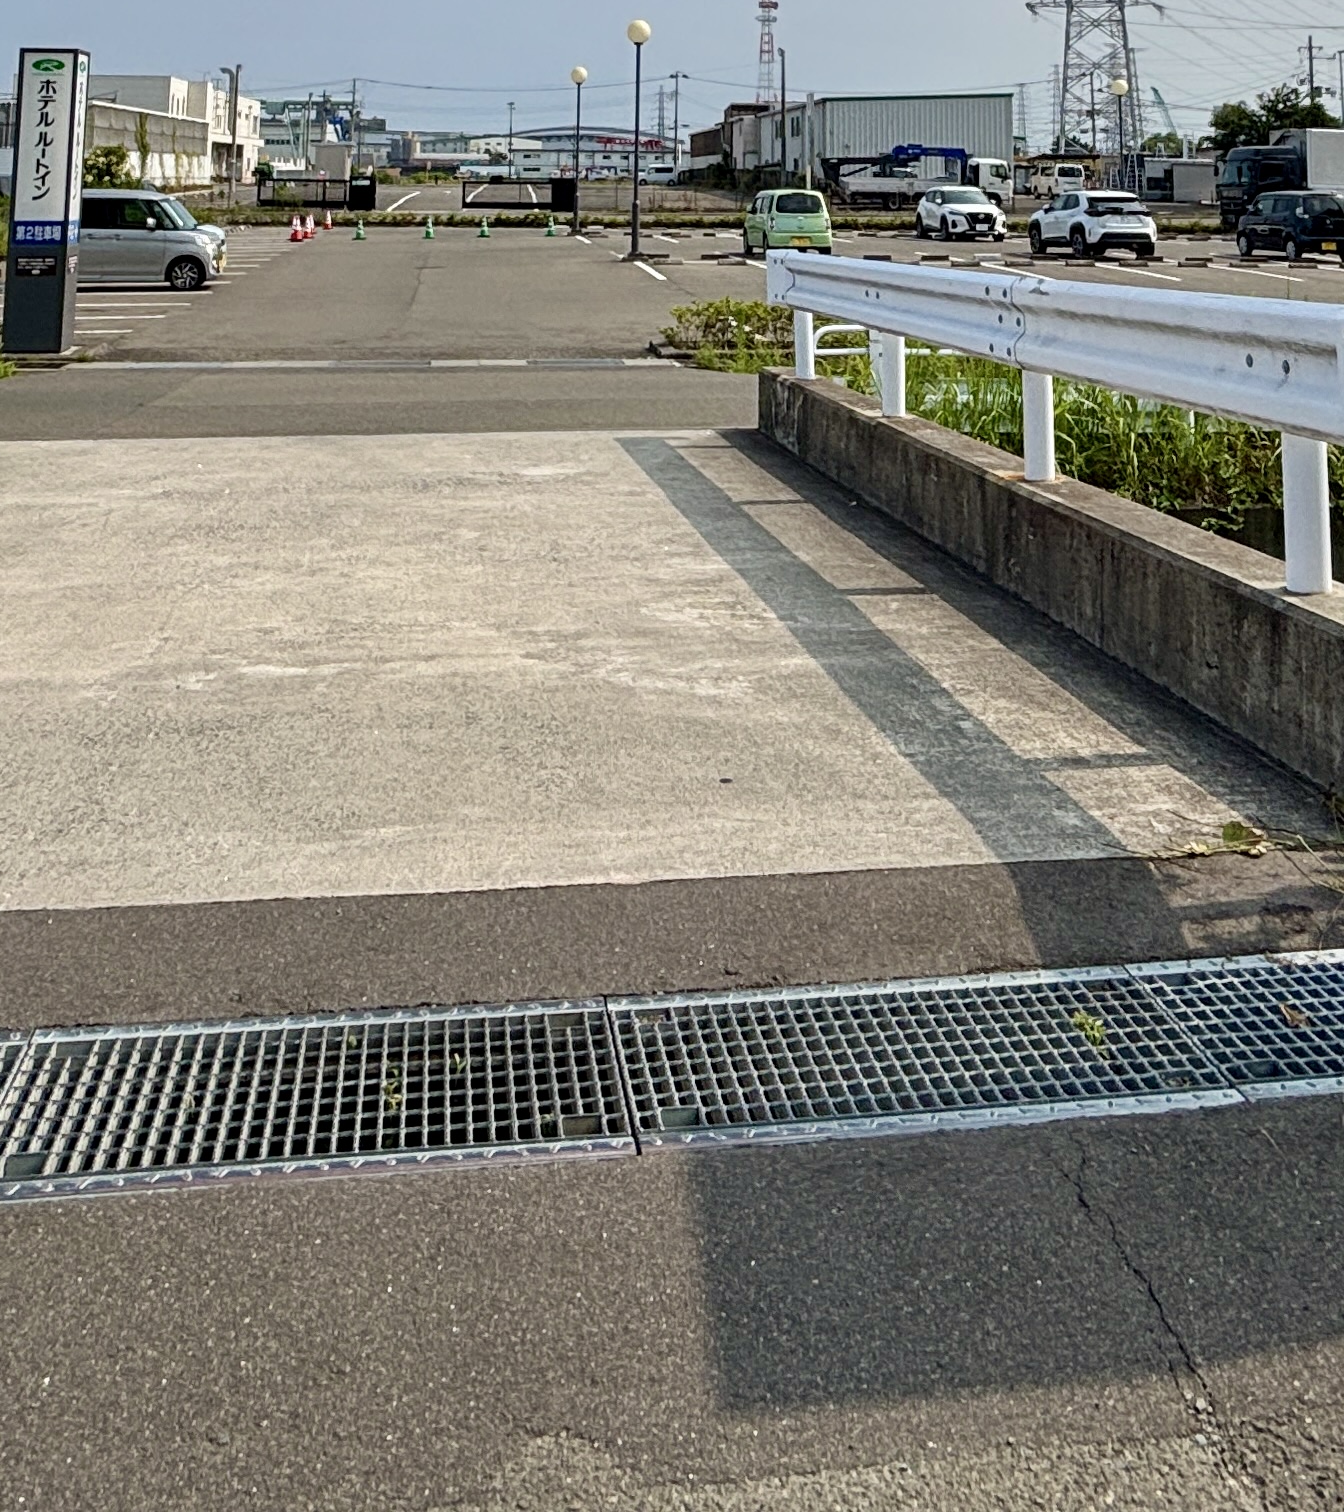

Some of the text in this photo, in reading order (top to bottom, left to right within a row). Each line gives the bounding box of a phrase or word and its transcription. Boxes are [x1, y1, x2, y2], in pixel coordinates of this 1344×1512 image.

[32, 78, 57, 201] ホテルルートイン
